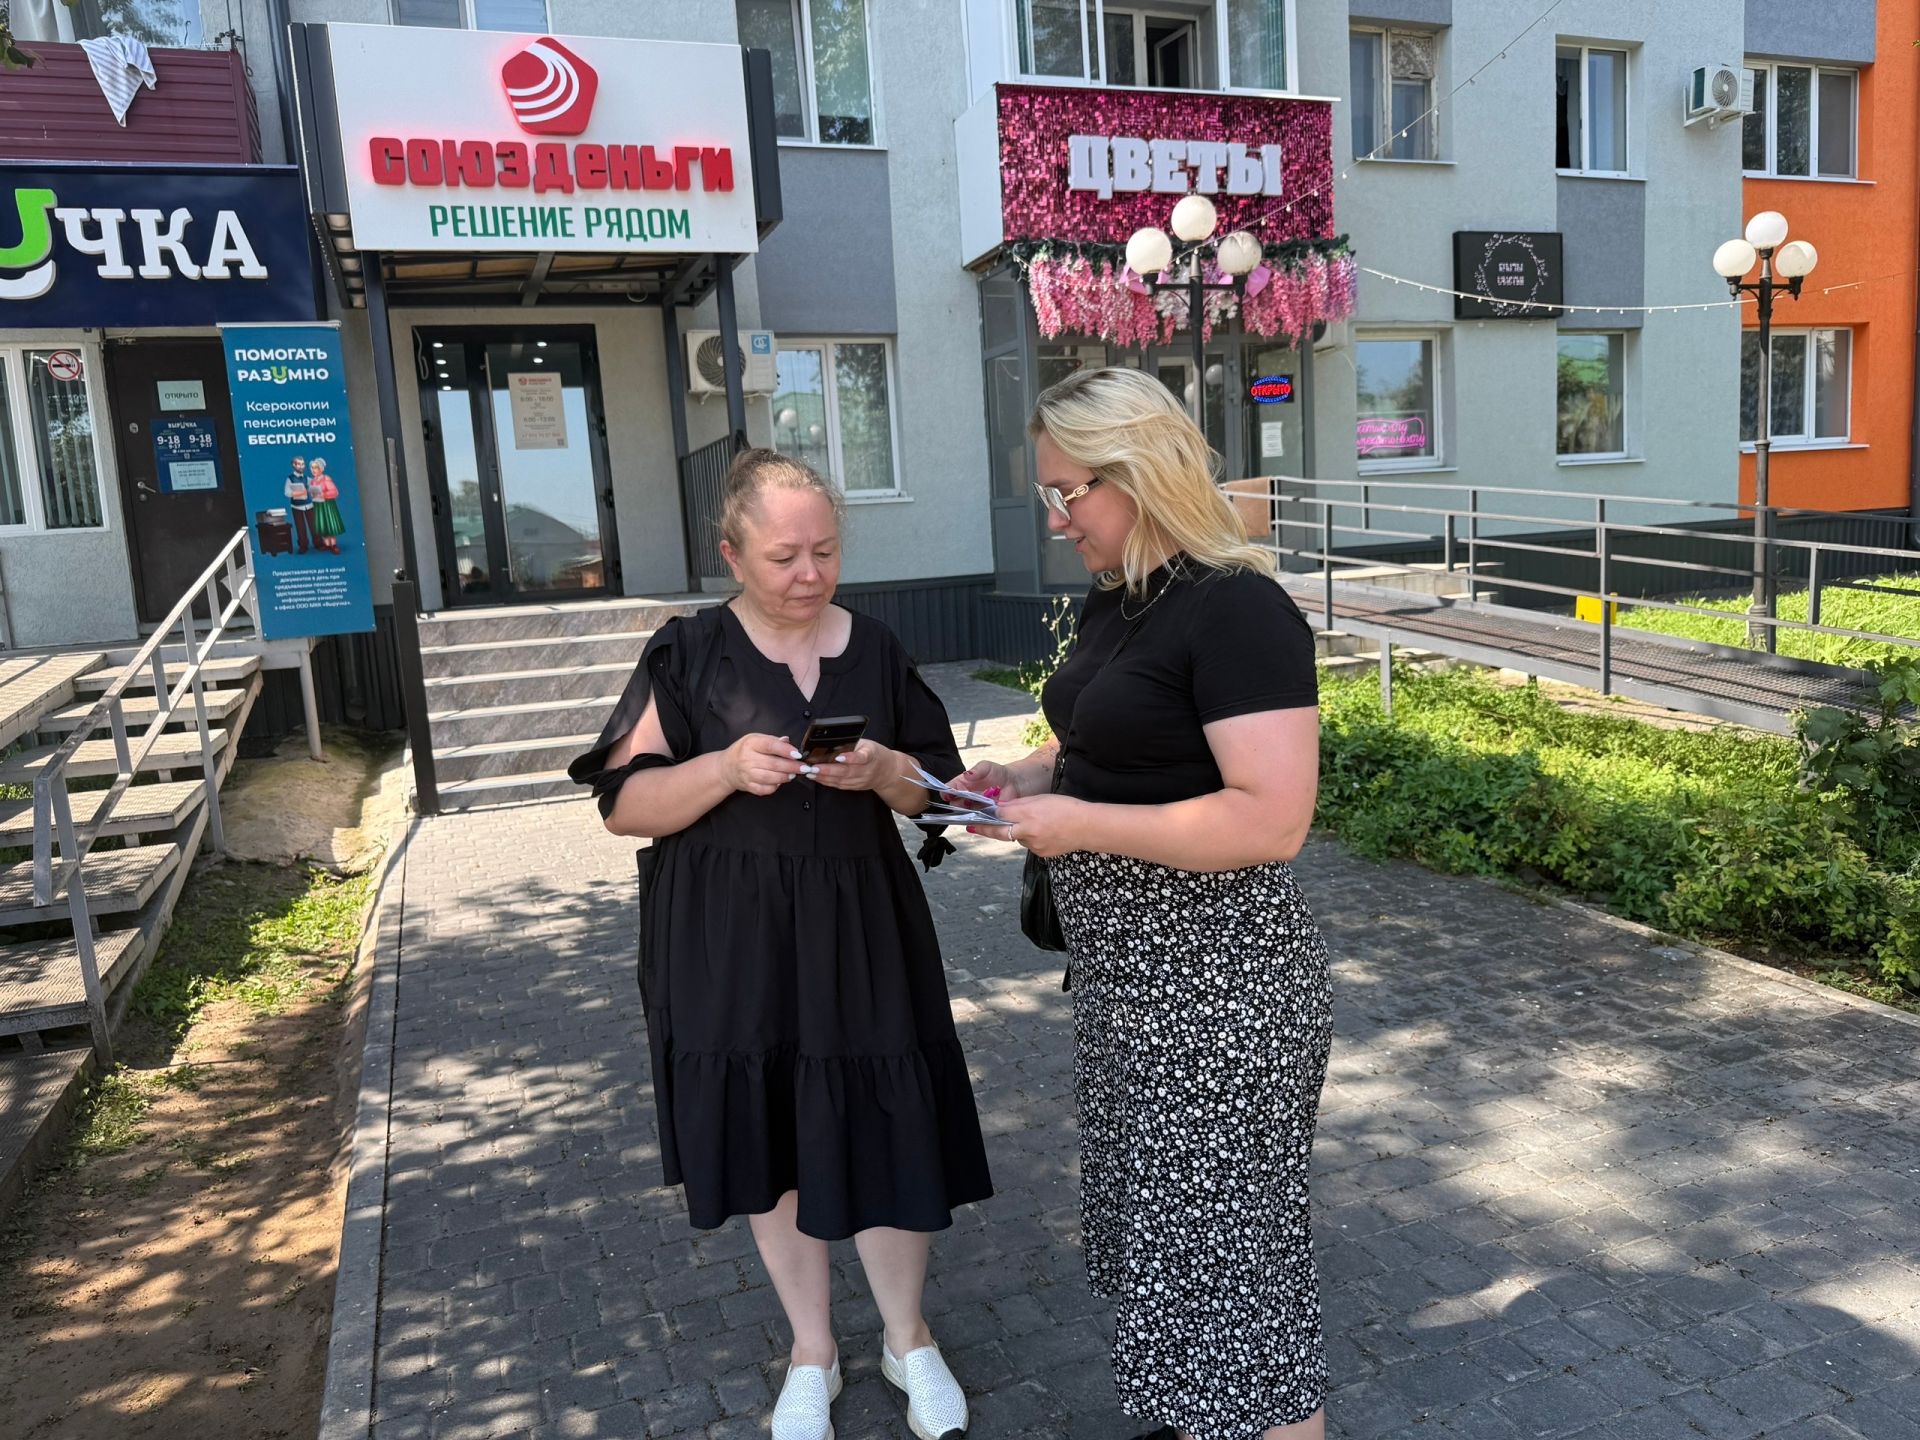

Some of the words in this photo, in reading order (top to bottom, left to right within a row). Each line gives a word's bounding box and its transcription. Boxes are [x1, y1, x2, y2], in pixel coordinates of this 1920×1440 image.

[1068, 135, 1283, 200] ЦВЕТЫ
[429, 205, 576, 239] РЕШЕНИЕ
[585, 207, 691, 243] РЯДОМ
[234, 348, 328, 361] ПОМОГАТЬ
[164, 392, 199, 400] ОТКРЫТО
[1250, 384, 1291, 397] ОТКРЫТО
[246, 401, 330, 413] Ксерокопии
[243, 417, 337, 429] пенсионерам
[157, 435, 180, 445] 9-18
[189, 434, 212, 444] 9-18
[248, 432, 336, 445] БЕСПЛАТНО
